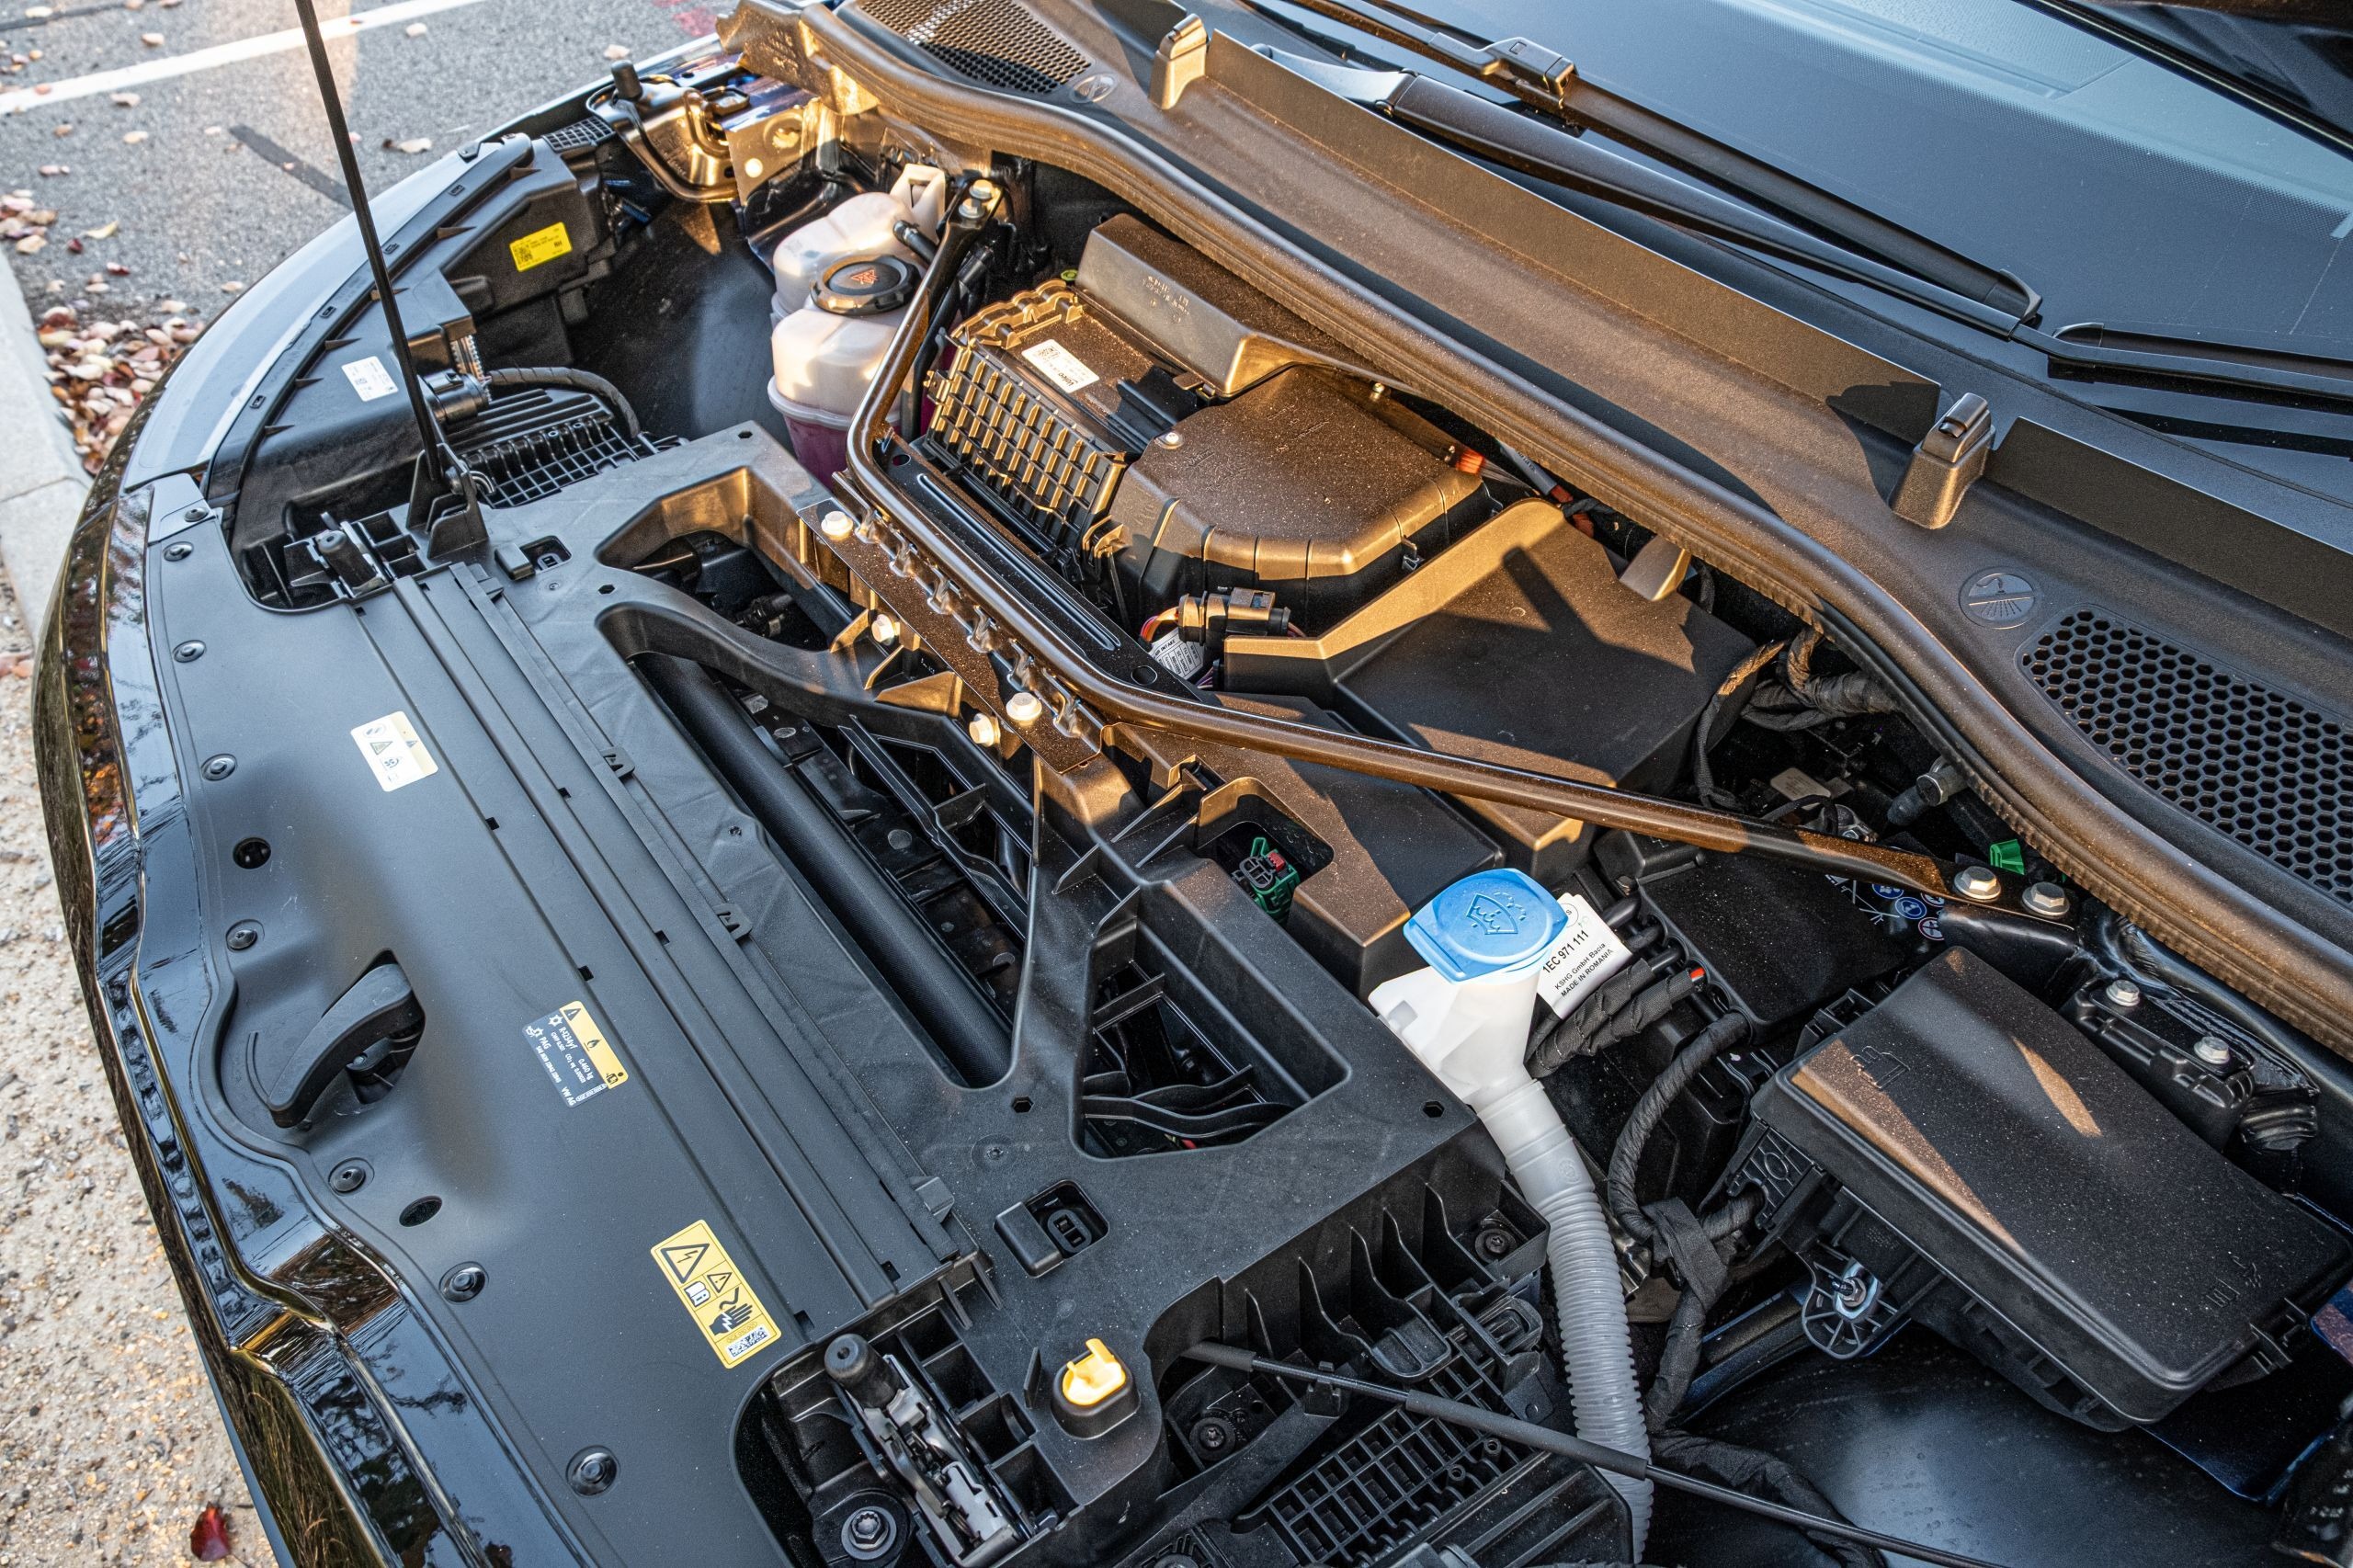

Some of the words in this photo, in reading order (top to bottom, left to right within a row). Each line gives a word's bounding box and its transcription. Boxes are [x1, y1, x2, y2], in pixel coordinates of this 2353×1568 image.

[1542, 956, 1561, 973] 1EC
[1558, 943, 1575, 960] 971
[1573, 929, 1589, 945] 111
[1554, 973, 1573, 990] KSHG
[1572, 957, 1590, 974] GmbH
[1561, 980, 1579, 997] MADE
[1578, 973, 1586, 982] IN
[1585, 949, 1614, 975] ROMANIA
[539, 1037, 551, 1050] PAG
[562, 1085, 572, 1097] VW
[566, 1096, 576, 1106] AG
